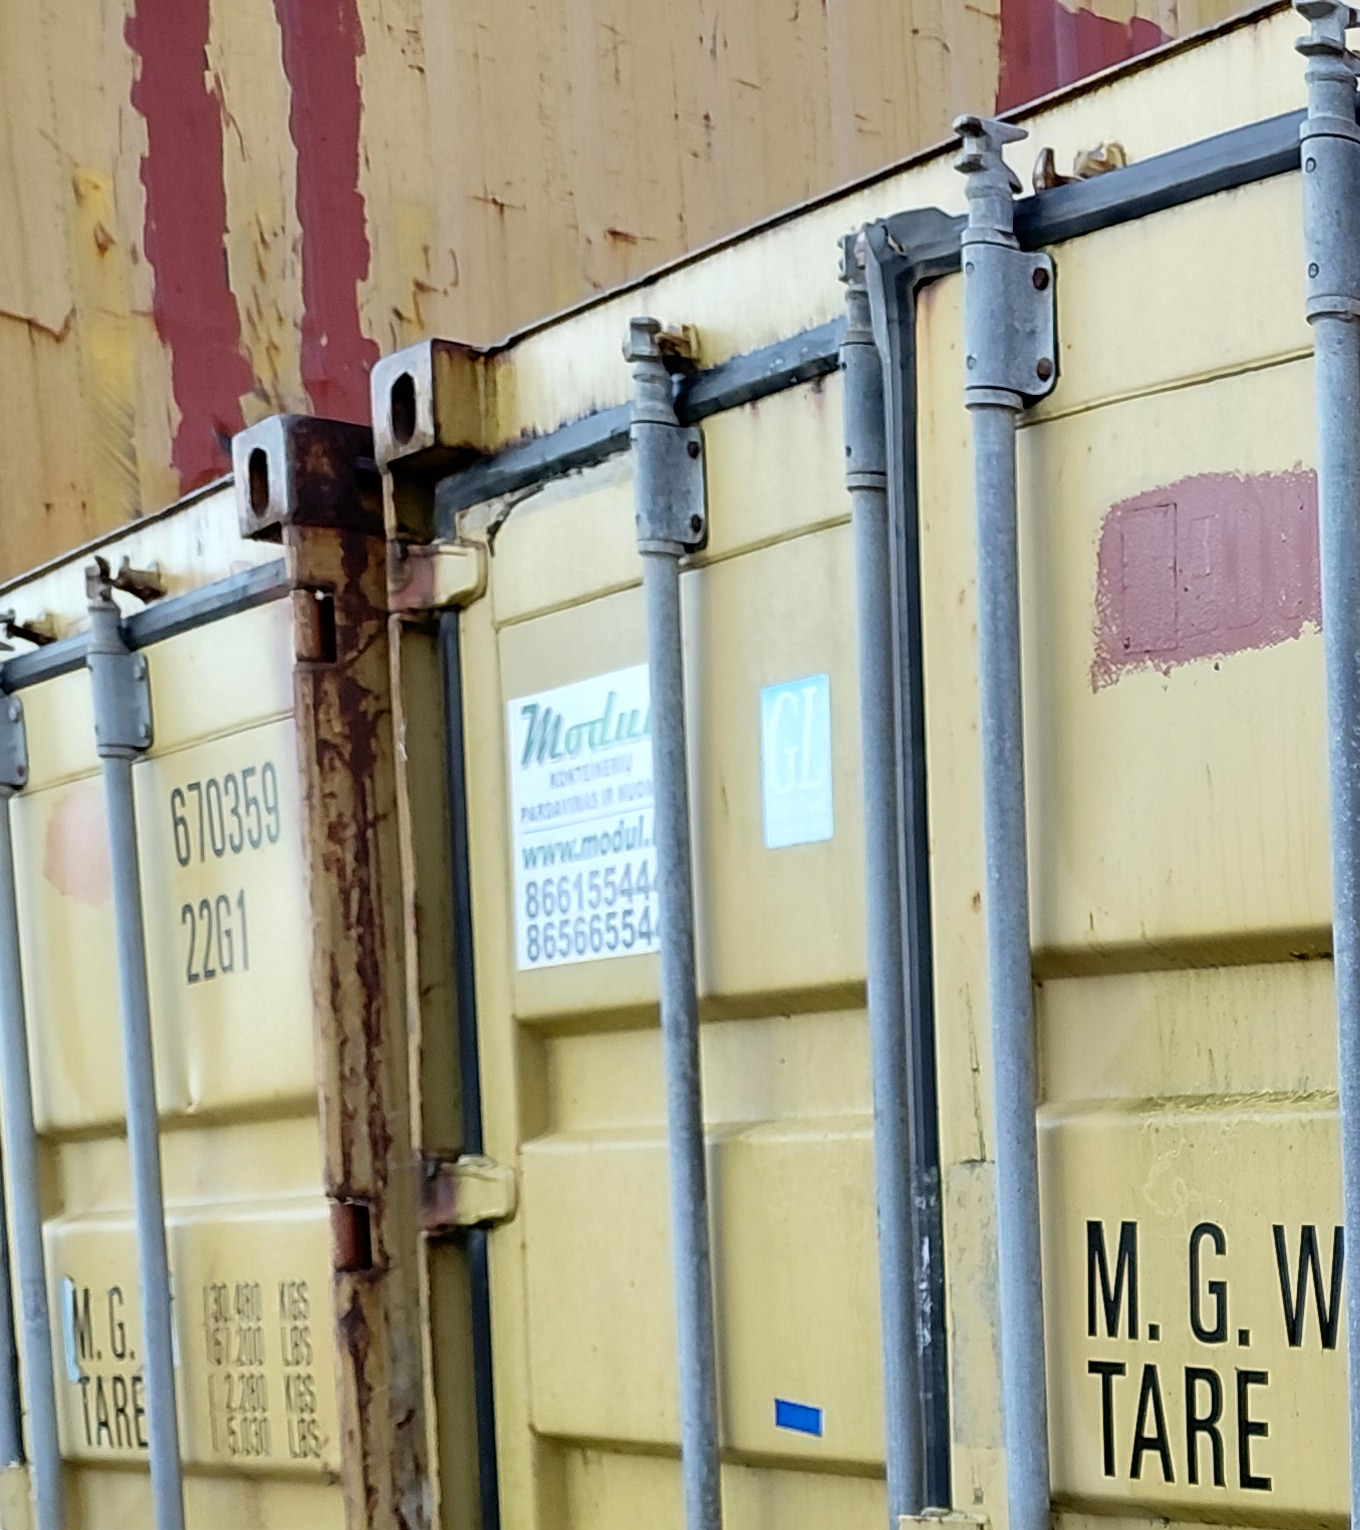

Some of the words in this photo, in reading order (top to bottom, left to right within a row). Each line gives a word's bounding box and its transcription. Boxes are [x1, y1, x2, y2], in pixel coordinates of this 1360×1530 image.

[170, 761, 282, 868] 670359
[521, 813, 656, 871] www.modul.
[525, 859, 659, 919] 86615544
[181, 888, 250, 986] 22G1
[526, 905, 660, 963] 86566554
[1086, 1220, 1160, 1341] M.
[1189, 1222, 1250, 1347] G.
[107, 1286, 136, 1360] G.
[77, 1375, 149, 1450] TARE
[1087, 1360, 1273, 1492] TARE
